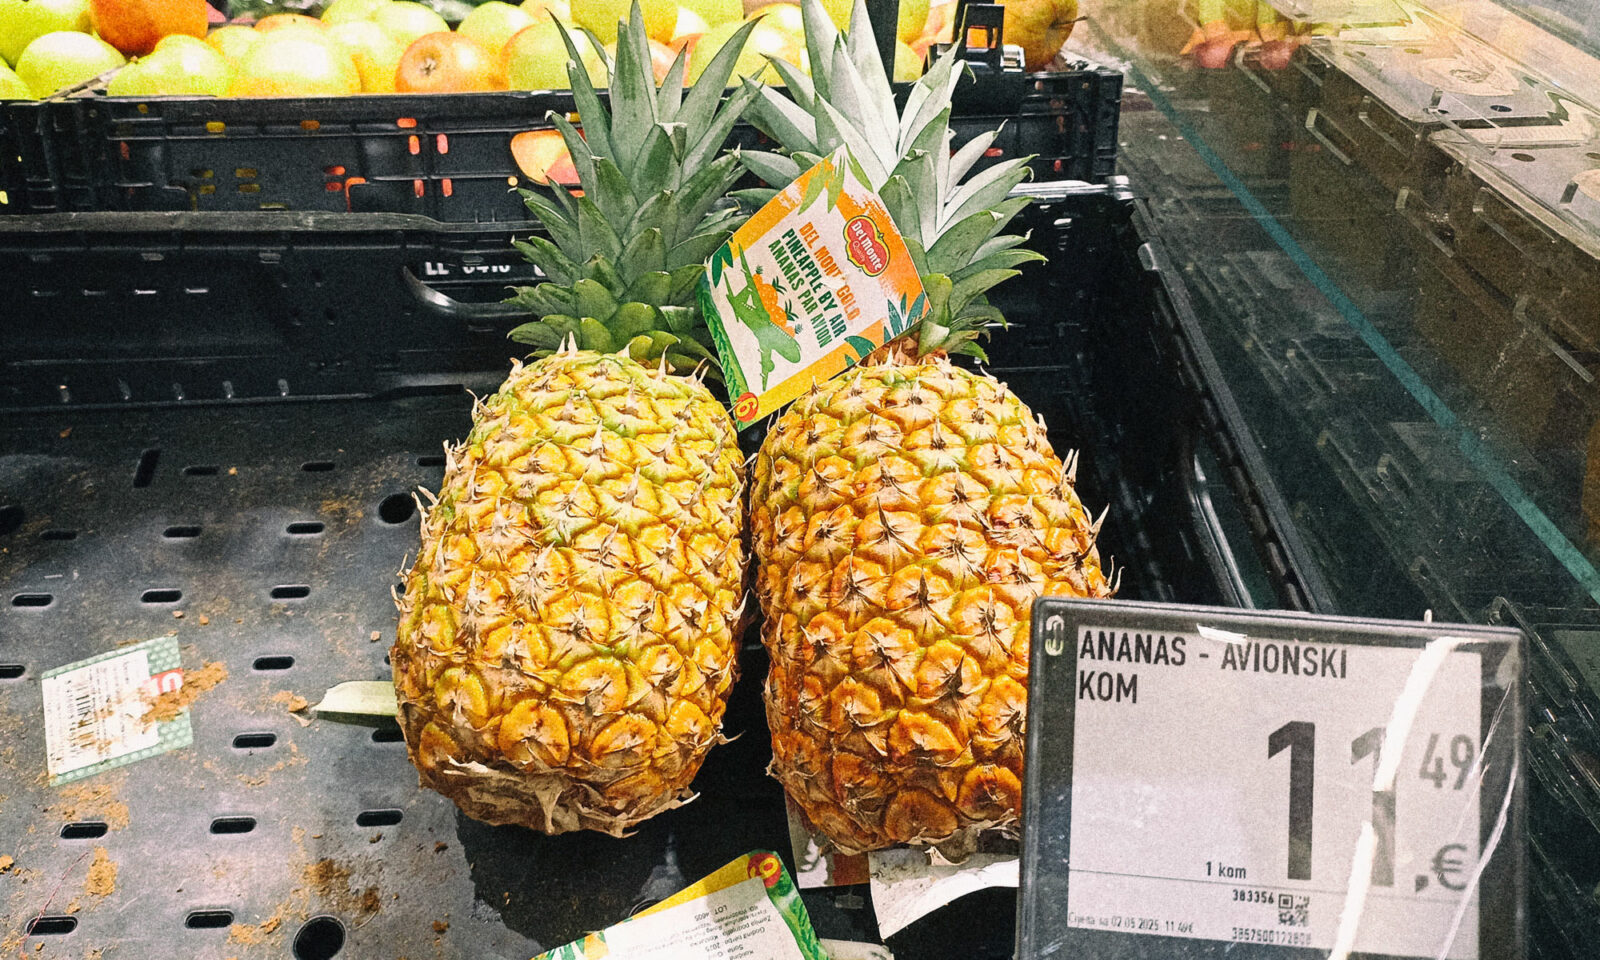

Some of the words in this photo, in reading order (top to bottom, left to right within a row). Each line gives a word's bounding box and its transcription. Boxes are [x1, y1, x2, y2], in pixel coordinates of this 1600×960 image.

[424, 261, 449, 276] LL
[851, 221, 867, 241] Del
[860, 237, 883, 270] Monte
[768, 238, 805, 291] ANANAS
[797, 288, 818, 315] PAR
[810, 312, 833, 348] AVION
[781, 227, 826, 294] PINEAPPLE
[818, 290, 838, 312] BY
[829, 313, 847, 338] AIR
[799, 221, 820, 249] DEL
[814, 245, 846, 280] MONT
[836, 284, 861, 321] GOLD
[1080, 630, 1186, 666] ANANAS
[1221, 642, 1347, 679] AVIONSKI
[1079, 670, 1138, 704] KOM
[1419, 733, 1475, 790] 49
[1206, 861, 1212, 876] 1
[1218, 862, 1247, 879] kom
[714, 904, 728, 915] LOT
[1232, 888, 1275, 905] 383356
